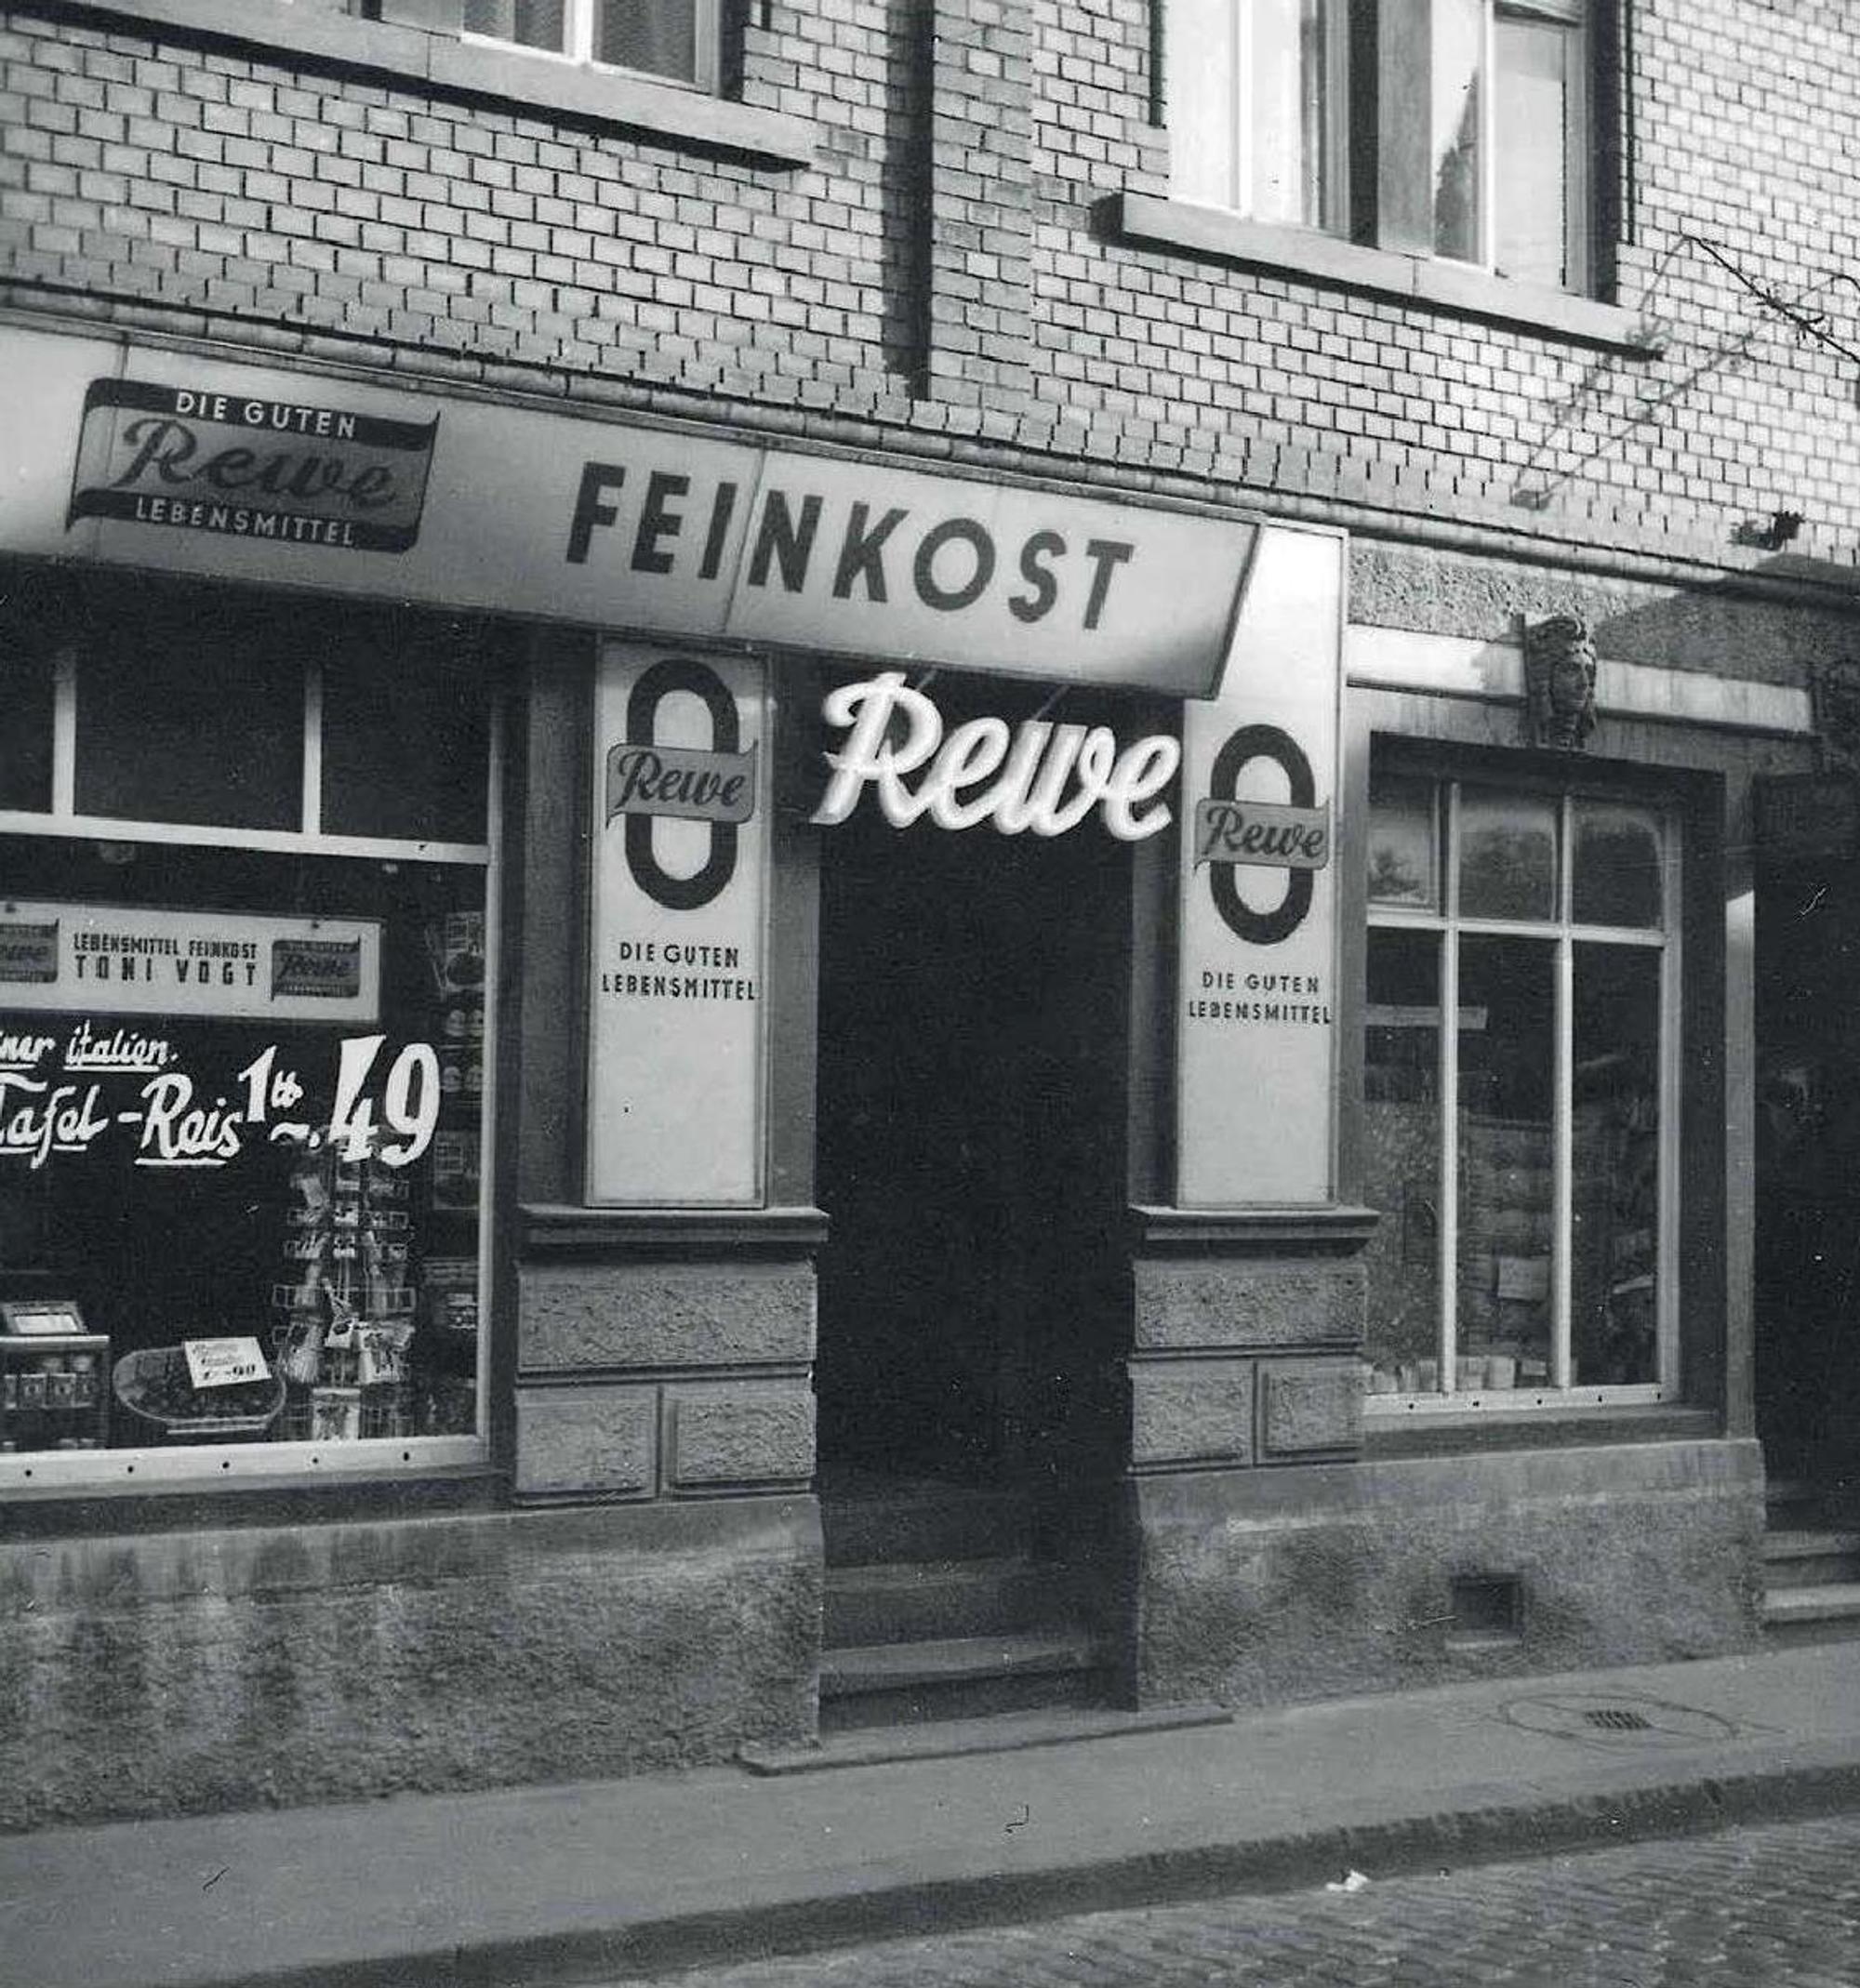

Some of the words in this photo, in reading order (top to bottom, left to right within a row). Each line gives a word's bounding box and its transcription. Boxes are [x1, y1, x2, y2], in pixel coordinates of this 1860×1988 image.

[176, 391, 228, 421] DIE
[245, 402, 356, 439] GUTEN
[109, 417, 396, 508] Rewe
[136, 497, 354, 547] LEBENSMITTEL
[565, 461, 1135, 630] FEINKOST
[615, 750, 745, 809] Rewe
[809, 671, 1181, 842] Rewe
[1204, 806, 1324, 858] Rewe
[73, 933, 179, 956] LEBENSMITTEL
[189, 940, 257, 960] FEINKOST
[75, 955, 153, 982] TONI
[176, 958, 256, 986] VOGT
[620, 942, 655, 961] DIE
[664, 945, 738, 968] GUTEN
[602, 974, 755, 1001] LEBENSMITTEL
[1202, 971, 1234, 989] DIE
[1245, 974, 1319, 993] GUTEN
[1189, 1001, 1332, 1024] LEBENSMITTEL
